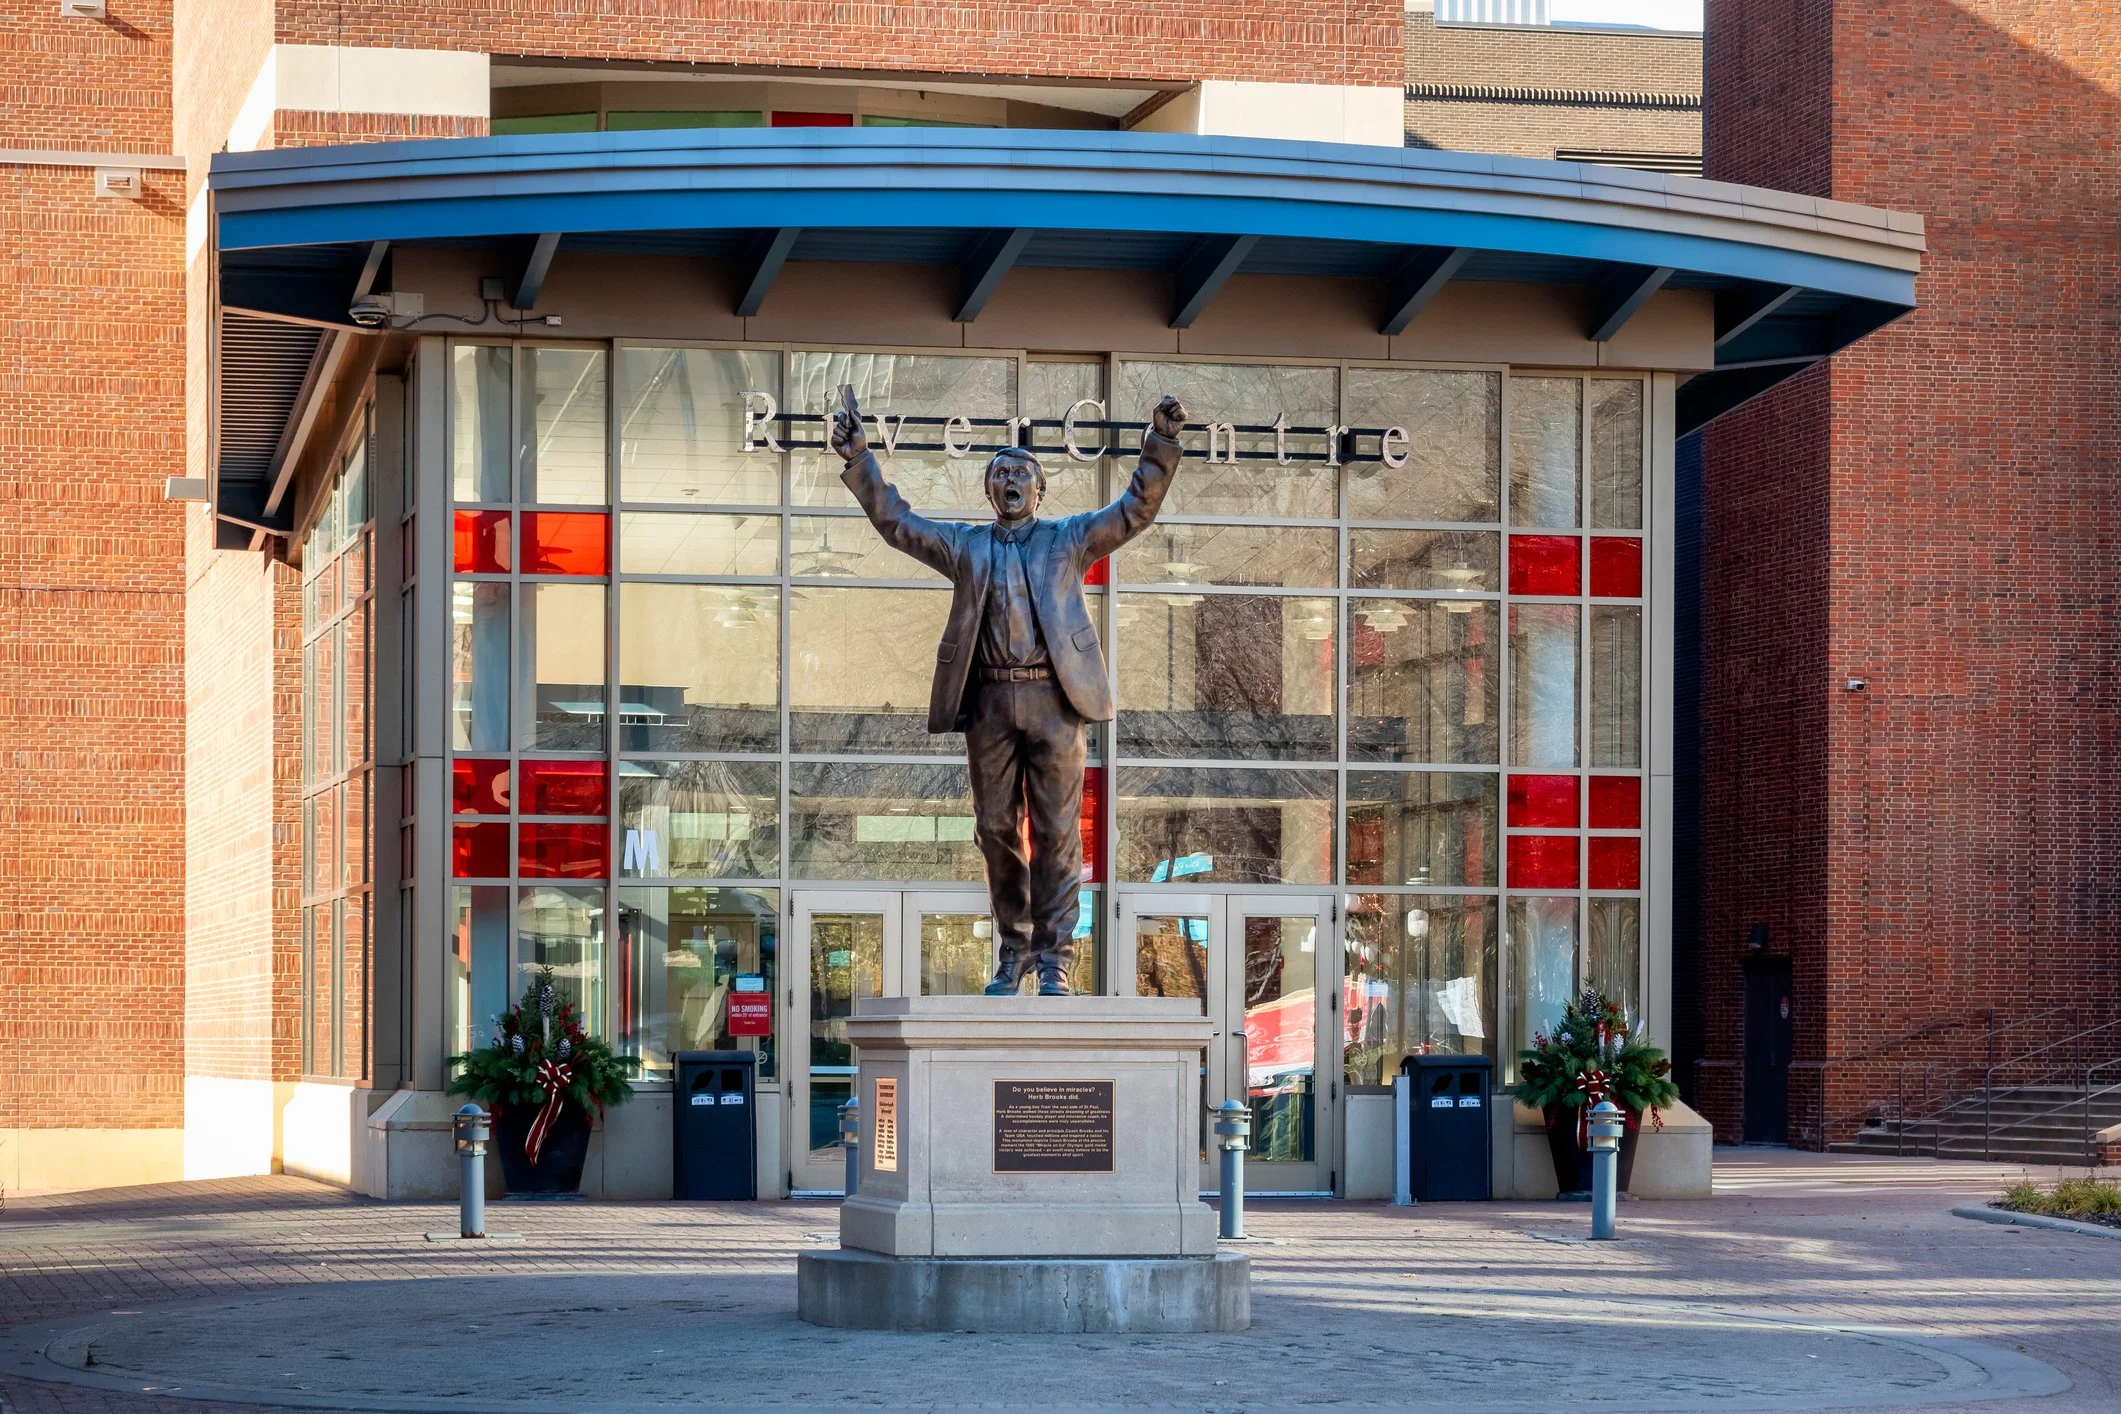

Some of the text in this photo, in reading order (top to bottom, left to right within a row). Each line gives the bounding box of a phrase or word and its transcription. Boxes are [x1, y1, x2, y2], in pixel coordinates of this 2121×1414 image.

[737, 389, 1410, 470] RiverCntre
[731, 1005, 768, 1013] NO SMOKING
